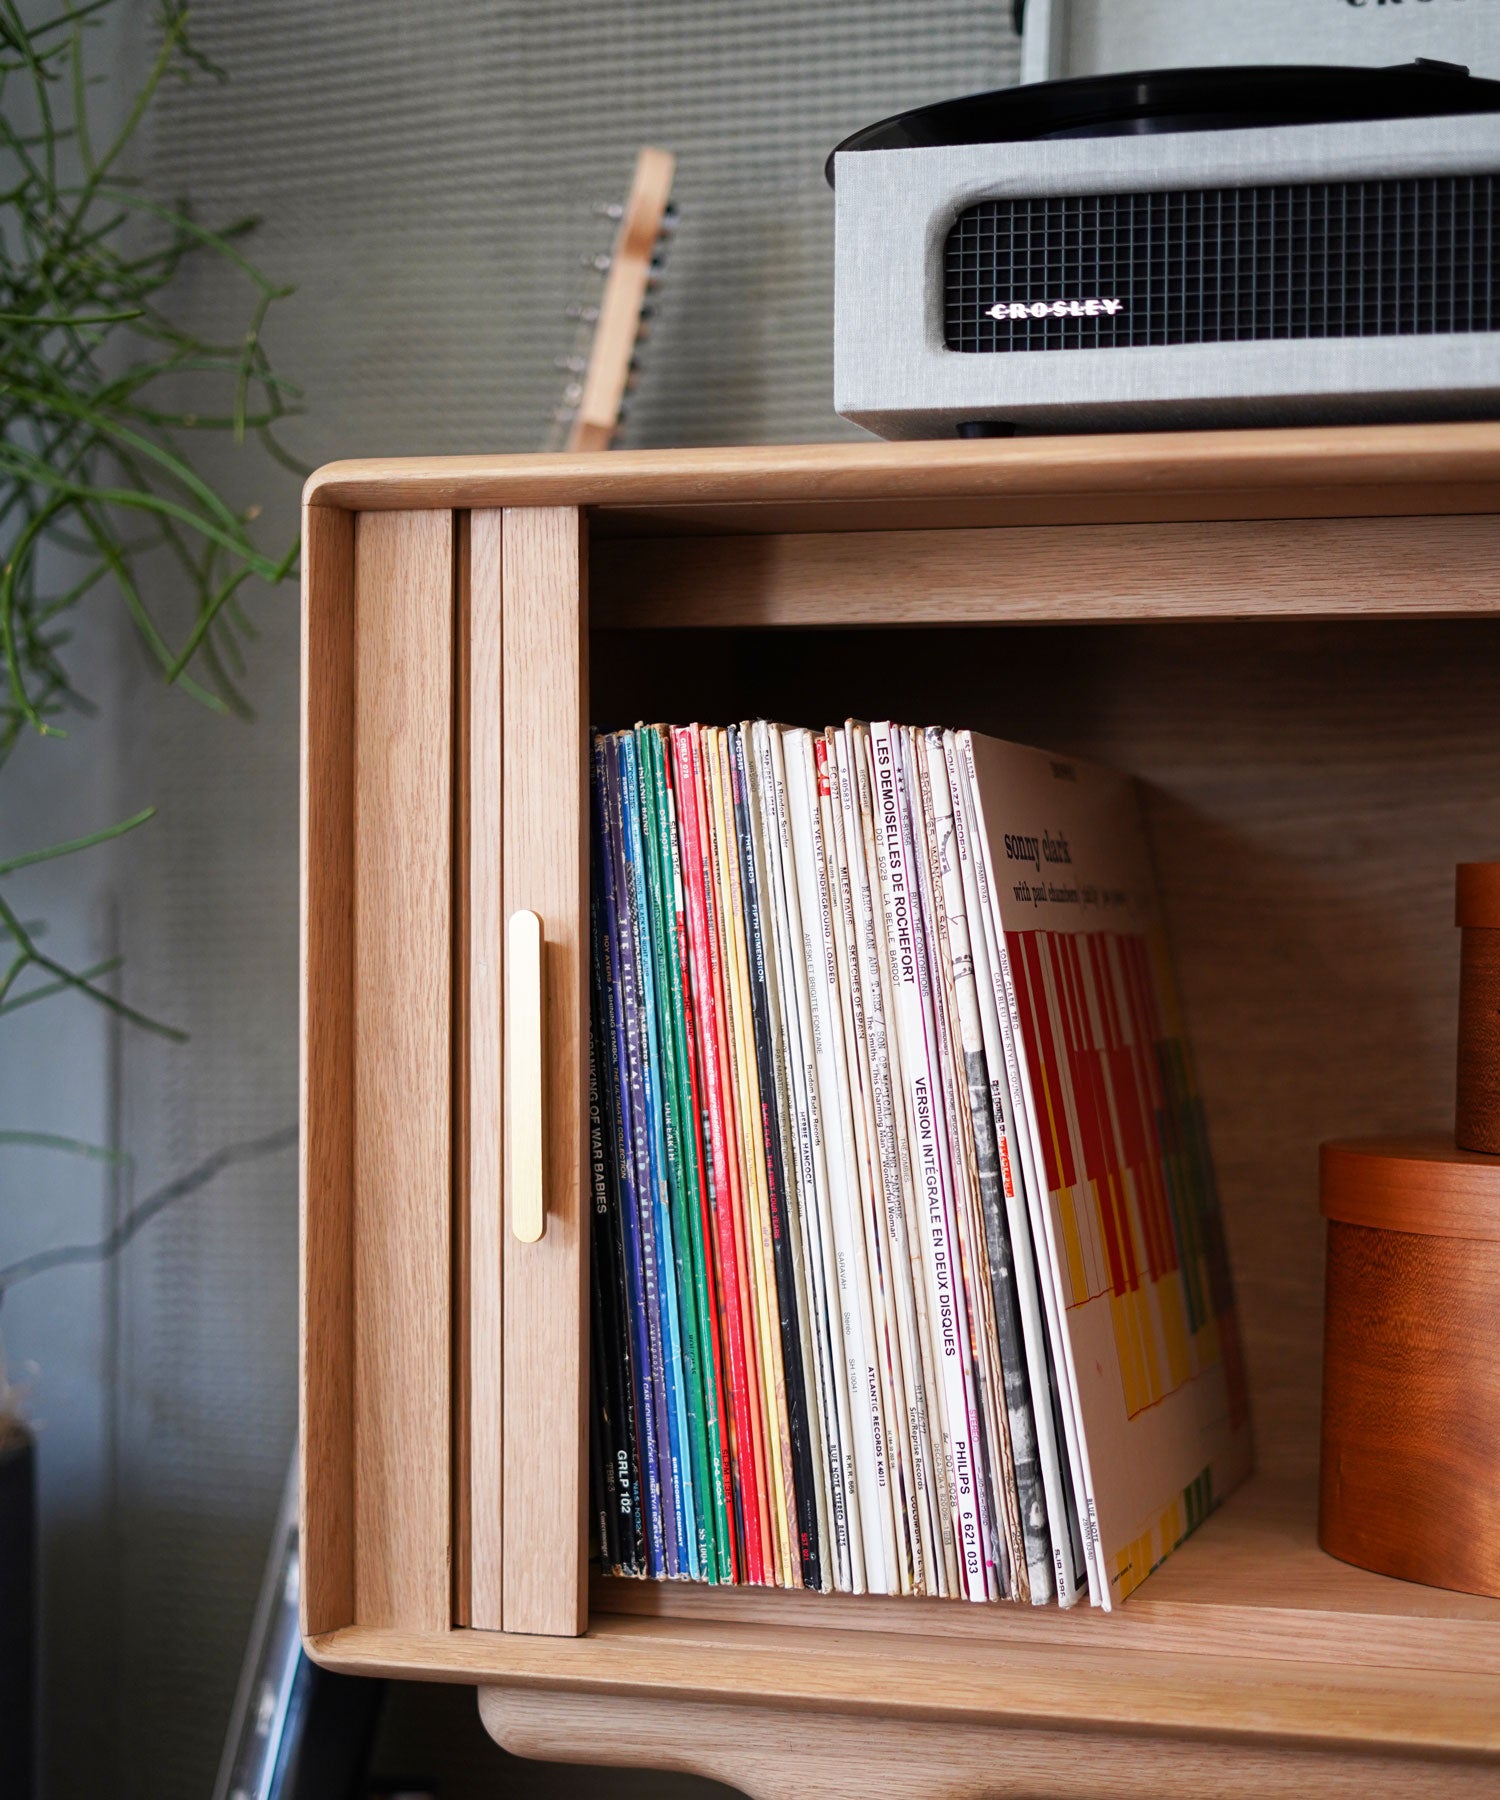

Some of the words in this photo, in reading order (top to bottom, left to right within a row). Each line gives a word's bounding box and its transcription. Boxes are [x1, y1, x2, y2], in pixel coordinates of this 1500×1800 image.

[986, 299, 1124, 319] CROSLEY
[876, 738, 889, 765] LES
[777, 789, 785, 818] Random
[842, 777, 850, 810] 40583-0
[880, 769, 901, 868] DEMOISELLES
[950, 780, 959, 806] JAZZ
[956, 811, 967, 860] RECORDS
[875, 828, 884, 846] DOT
[1004, 833, 1040, 872] sonny
[1042, 829, 1072, 863] clark
[747, 855, 755, 884] BYRDS
[840, 867, 849, 894] MILES
[878, 856, 888, 881] 5028
[892, 873, 904, 892] DE
[815, 830, 825, 863] VELVET
[826, 947, 836, 984] LOADED
[861, 886, 872, 912] MARC
[883, 893, 891, 906] LA
[1013, 881, 1032, 902] with
[1031, 882, 1048, 908] paul
[844, 898, 853, 925] DAVIS
[620, 919, 629, 949] THE
[865, 919, 875, 949] BOLAN
[885, 912, 895, 943] BELLE
[894, 897, 914, 984] ROCHEFORT
[754, 933, 764, 982] DIMENSION
[808, 964, 815, 974] ET
[848, 945, 860, 993] SKETCHES
[869, 956, 878, 975] AND
[890, 950, 900, 987] BARDOT
[915, 936, 929, 997] CONTORTIONS
[624, 964, 634, 1005] HIGH
[809, 976, 819, 1012] BRIGITTE
[607, 994, 616, 1028] SHINING
[854, 997, 862, 1008] OF
[813, 1015, 823, 1054] FONTAINE
[856, 1011, 865, 1040] SPAIN
[866, 1016, 874, 1030] The
[610, 1030, 618, 1064] SYMBOL
[628, 1019, 640, 1090] LLAMAS
[868, 1032, 878, 1061] Smiths
[877, 1031, 886, 1049] SON
[997, 996, 1007, 1017] BLEU
[1005, 1042, 1014, 1070] STYLE
[1010, 1071, 1021, 1107] COUNCIL
[878, 1056, 888, 1069] OF
[807, 1064, 815, 1094] Random
[590, 1105, 600, 1124] OF
[615, 1084, 623, 1125] ULTIMATE
[810, 1095, 818, 1116] Radar
[874, 1087, 886, 1128] Charming
[915, 1078, 932, 1139] VERSION
[800, 1112, 808, 1138] HERBIE
[592, 1127, 603, 1159] WAR
[618, 1127, 627, 1179] COLLECTION
[637, 1126, 646, 1170] COLD
[803, 1143, 812, 1184] HANCOCK
[594, 1163, 607, 1214] BABIES
[923, 1144, 941, 1223] INTÉGRALE
[640, 1185, 649, 1218] AND
[773, 1215, 781, 1239] YEARS
[933, 1228, 944, 1247] EN
[644, 1232, 655, 1300] BOUNCY
[838, 1252, 847, 1290] SARAVAH
[935, 1252, 949, 1290] DEUX
[939, 1295, 955, 1356] DISQUES
[849, 1359, 855, 1369] SH
[850, 1372, 858, 1393] 10041
[868, 1366, 878, 1412] ATLANTIC
[873, 1416, 883, 1457] RECORDS
[969, 1409, 980, 1443] STEREO
[830, 1445, 838, 1463] BLUE
[910, 1407, 920, 1456] Sire/Reprise
[915, 1458, 924, 1490] Records
[618, 1450, 629, 1488] GRLP
[832, 1467, 840, 1488] NOTE
[877, 1461, 886, 1487] K40113
[945, 1455, 953, 1473] DOT
[955, 1442, 970, 1494] PHILIPS
[620, 1491, 631, 1514] 102
[835, 1492, 843, 1520] STEREO
[948, 1482, 957, 1507] 5028
[1087, 1498, 1095, 1517] BLUE
[699, 1529, 706, 1540] SS
[965, 1524, 975, 1546] 621
[1090, 1522, 1098, 1543] NOTE
[968, 1551, 978, 1574] 033
